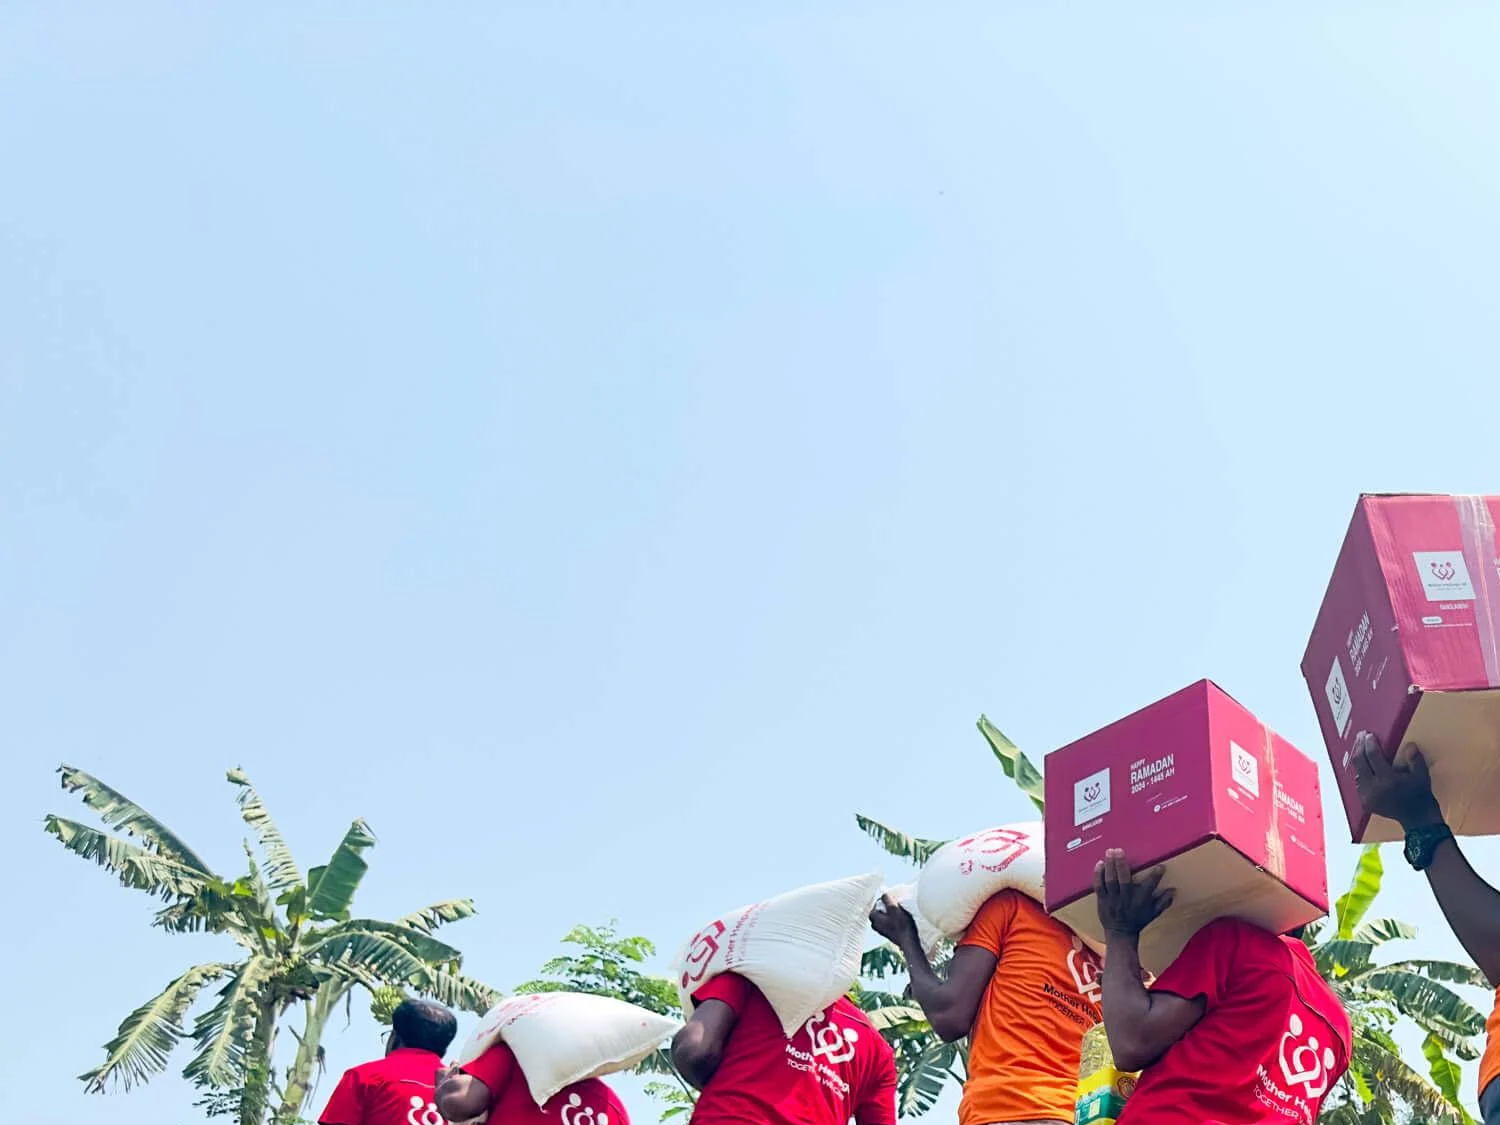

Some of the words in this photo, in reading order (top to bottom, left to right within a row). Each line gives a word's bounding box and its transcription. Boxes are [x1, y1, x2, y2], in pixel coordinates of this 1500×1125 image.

[1131, 753, 1174, 784] RAMADAN
[1165, 767, 1175, 778] AH
[1044, 983, 1079, 1009] Mother
[1256, 1064, 1293, 1103] Mother
